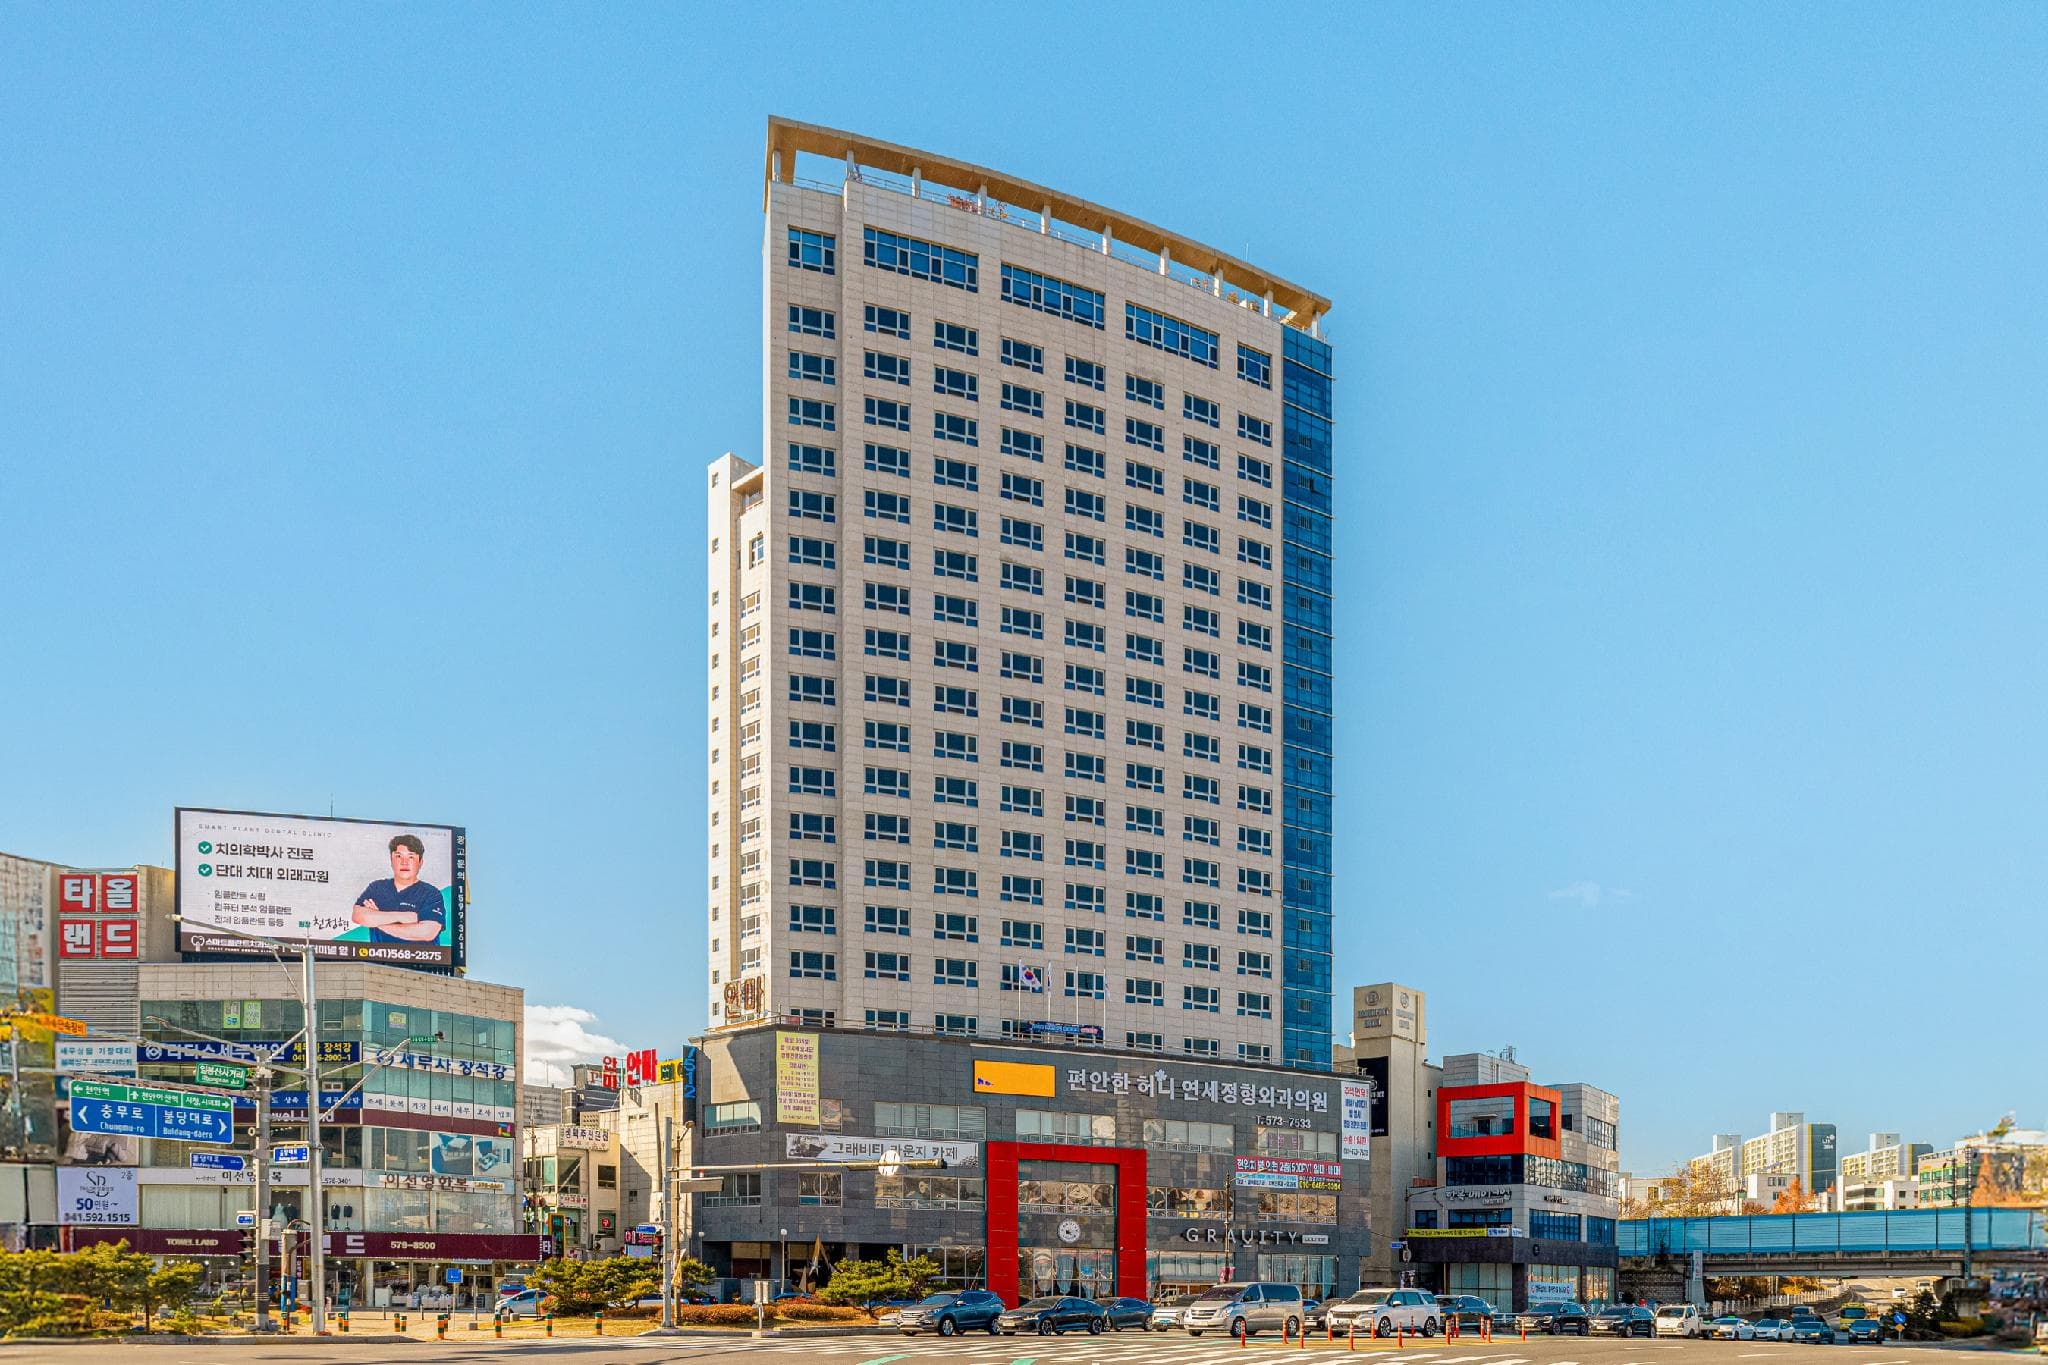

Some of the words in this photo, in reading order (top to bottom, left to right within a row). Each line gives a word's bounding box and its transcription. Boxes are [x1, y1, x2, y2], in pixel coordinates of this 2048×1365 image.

[216, 842, 283, 859] 치의학박사
[287, 847, 314, 860] 진료
[216, 864, 242, 878] 단대
[246, 866, 273, 880] 치대
[277, 868, 329, 883] 외래교원
[64, 878, 133, 909] 타올
[64, 923, 133, 953] 랜드
[368, 948, 442, 961] 041)568-2875
[98, 1047, 131, 1055] 기장대리
[324, 1043, 352, 1053] 장석강
[400, 1053, 451, 1072] 세무사
[459, 1060, 507, 1080] 장석강
[626, 1049, 658, 1086] 안마
[86, 1086, 110, 1096] 천안역
[142, 1092, 178, 1103] 천안아산역
[1068, 1069, 1131, 1095] 편안한
[1137, 1072, 1175, 1100] 허니
[1182, 1078, 1328, 1113] 연세정형외과의원
[101, 1104, 144, 1119] 충무로
[163, 1110, 213, 1126] 불당대로
[100, 1121, 145, 1133] Chungmu-ro
[163, 1127, 213, 1139] Buldang-daero
[832, 1143, 884, 1157] 그래비티
[932, 1146, 958, 1160] 카페
[121, 1170, 134, 1181] 2층
[386, 1173, 469, 1192] 이선영한복
